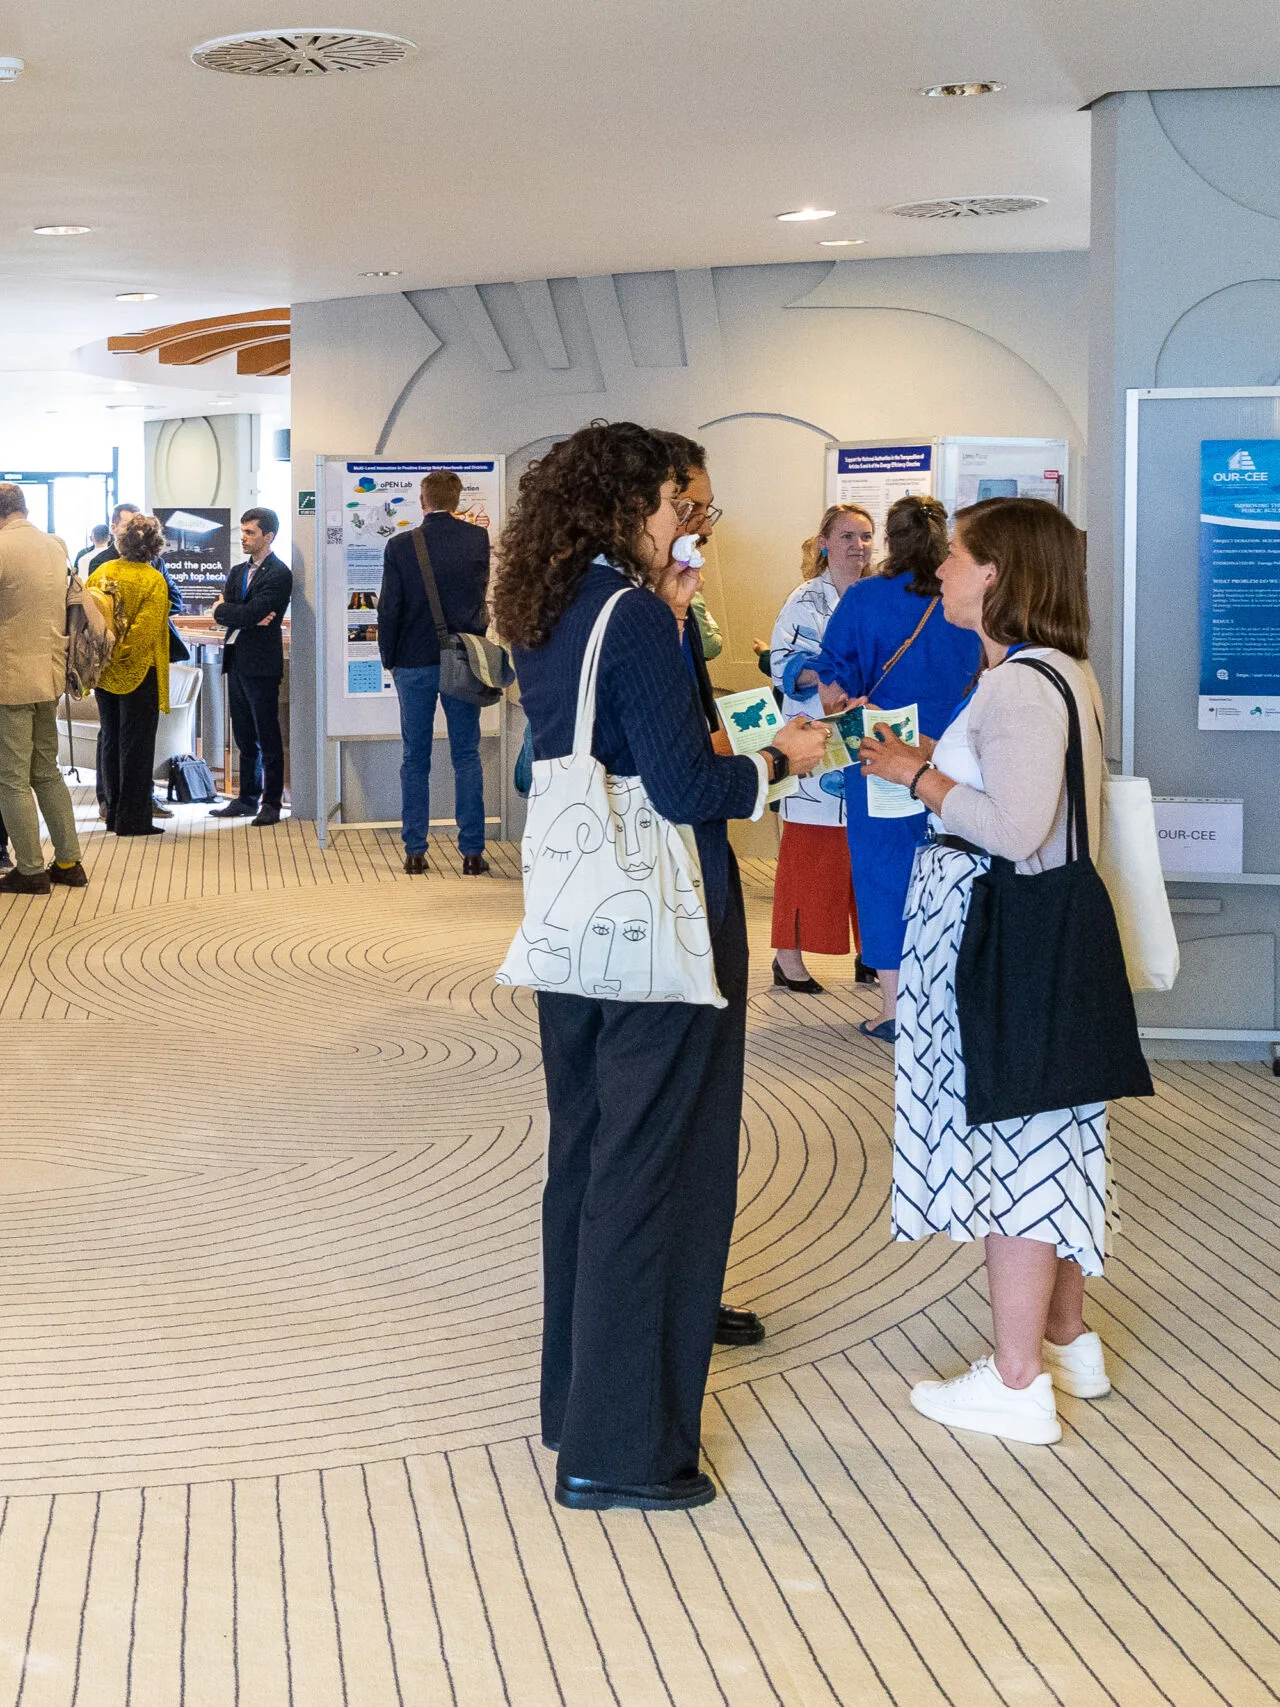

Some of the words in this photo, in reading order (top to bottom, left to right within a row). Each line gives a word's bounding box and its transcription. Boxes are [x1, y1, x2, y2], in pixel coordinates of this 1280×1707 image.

[1213, 472, 1268, 482] OUR-CEE
[165, 561, 182, 570] ead
[183, 561, 199, 570] the
[200, 561, 223, 572] pack
[169, 572, 189, 583] ough
[189, 572, 205, 583] top
[206, 572, 226, 581] tech
[1158, 829, 1217, 841] OUR-CEE
